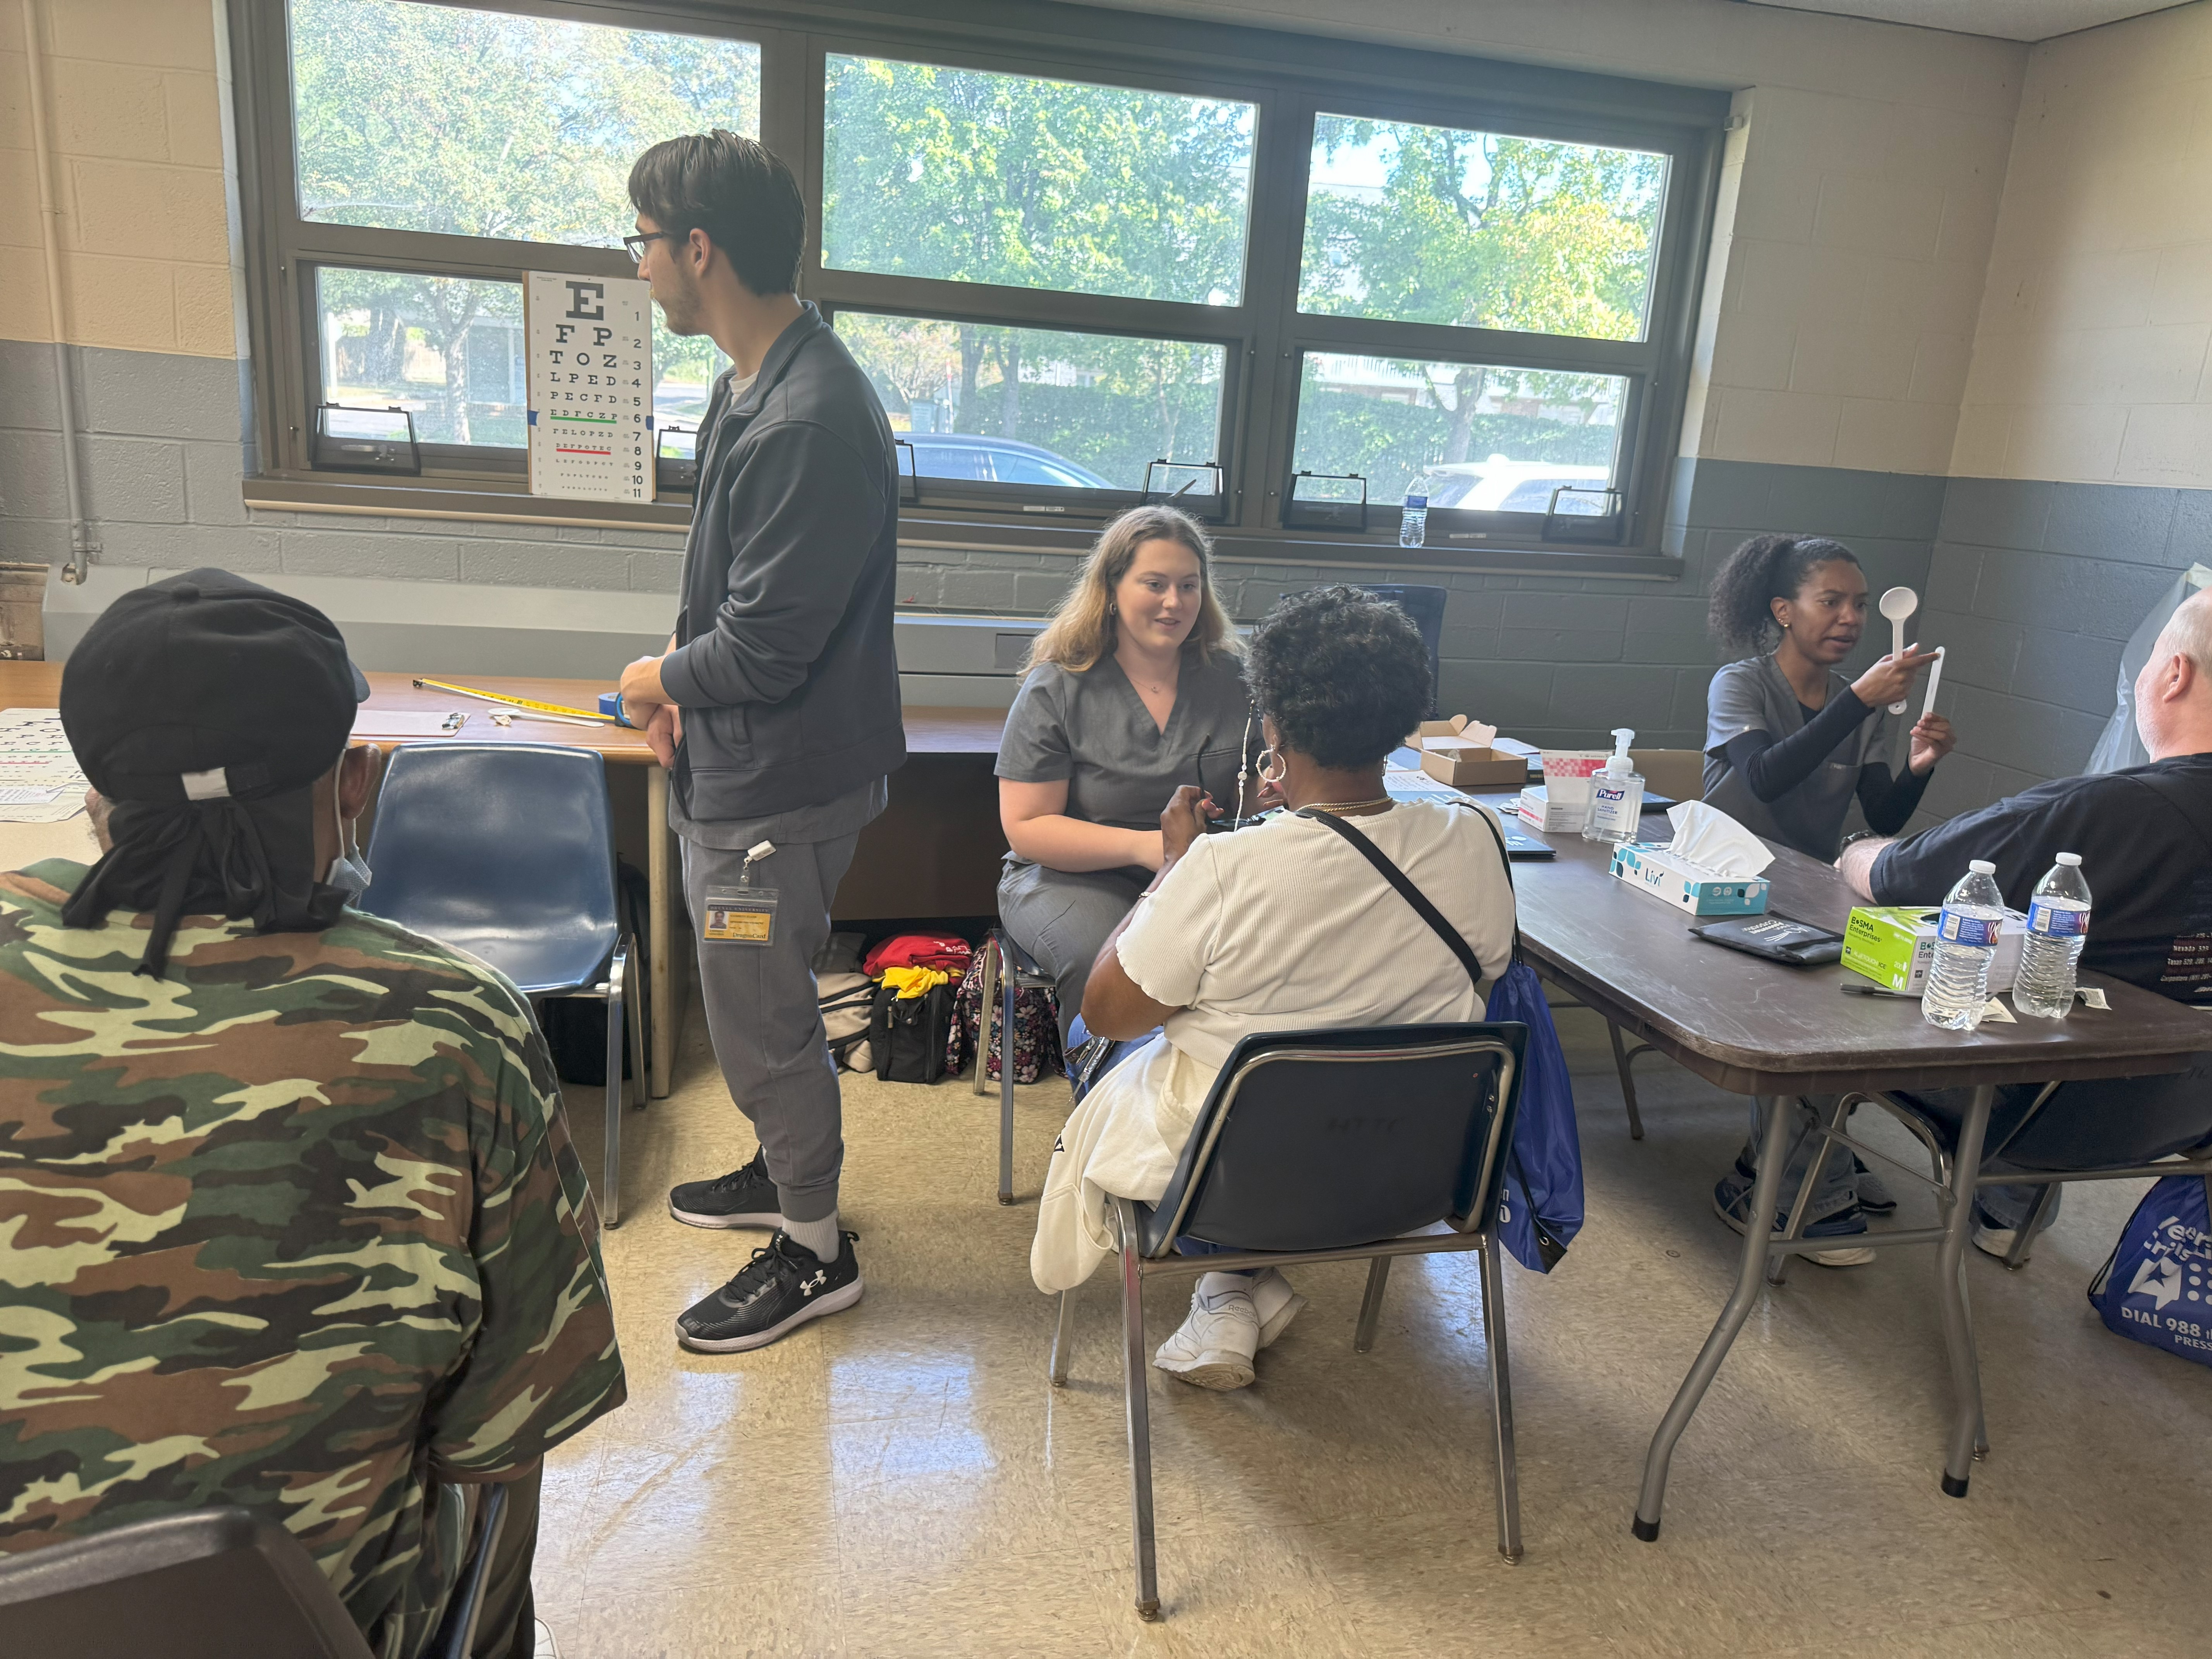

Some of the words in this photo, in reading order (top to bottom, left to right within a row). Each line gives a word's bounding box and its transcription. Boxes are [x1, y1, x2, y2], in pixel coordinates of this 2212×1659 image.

[565, 280, 604, 321] E
[635, 311, 639, 321] 1
[633, 338, 642, 349] 2
[633, 361, 641, 371] 3
[631, 378, 642, 388] 4
[633, 397, 641, 407] 5
[634, 414, 641, 423] 6
[632, 431, 641, 441] 7
[634, 446, 642, 456] 8
[634, 461, 642, 471] 9
[632, 475, 643, 485] 10
[633, 488, 641, 498] 11
[1599, 789, 1622, 800] Purell
[2121, 1307, 2162, 1328] DIAL
[2166, 1318, 2201, 1337] 988
[2174, 1334, 2212, 1351] PRESS
